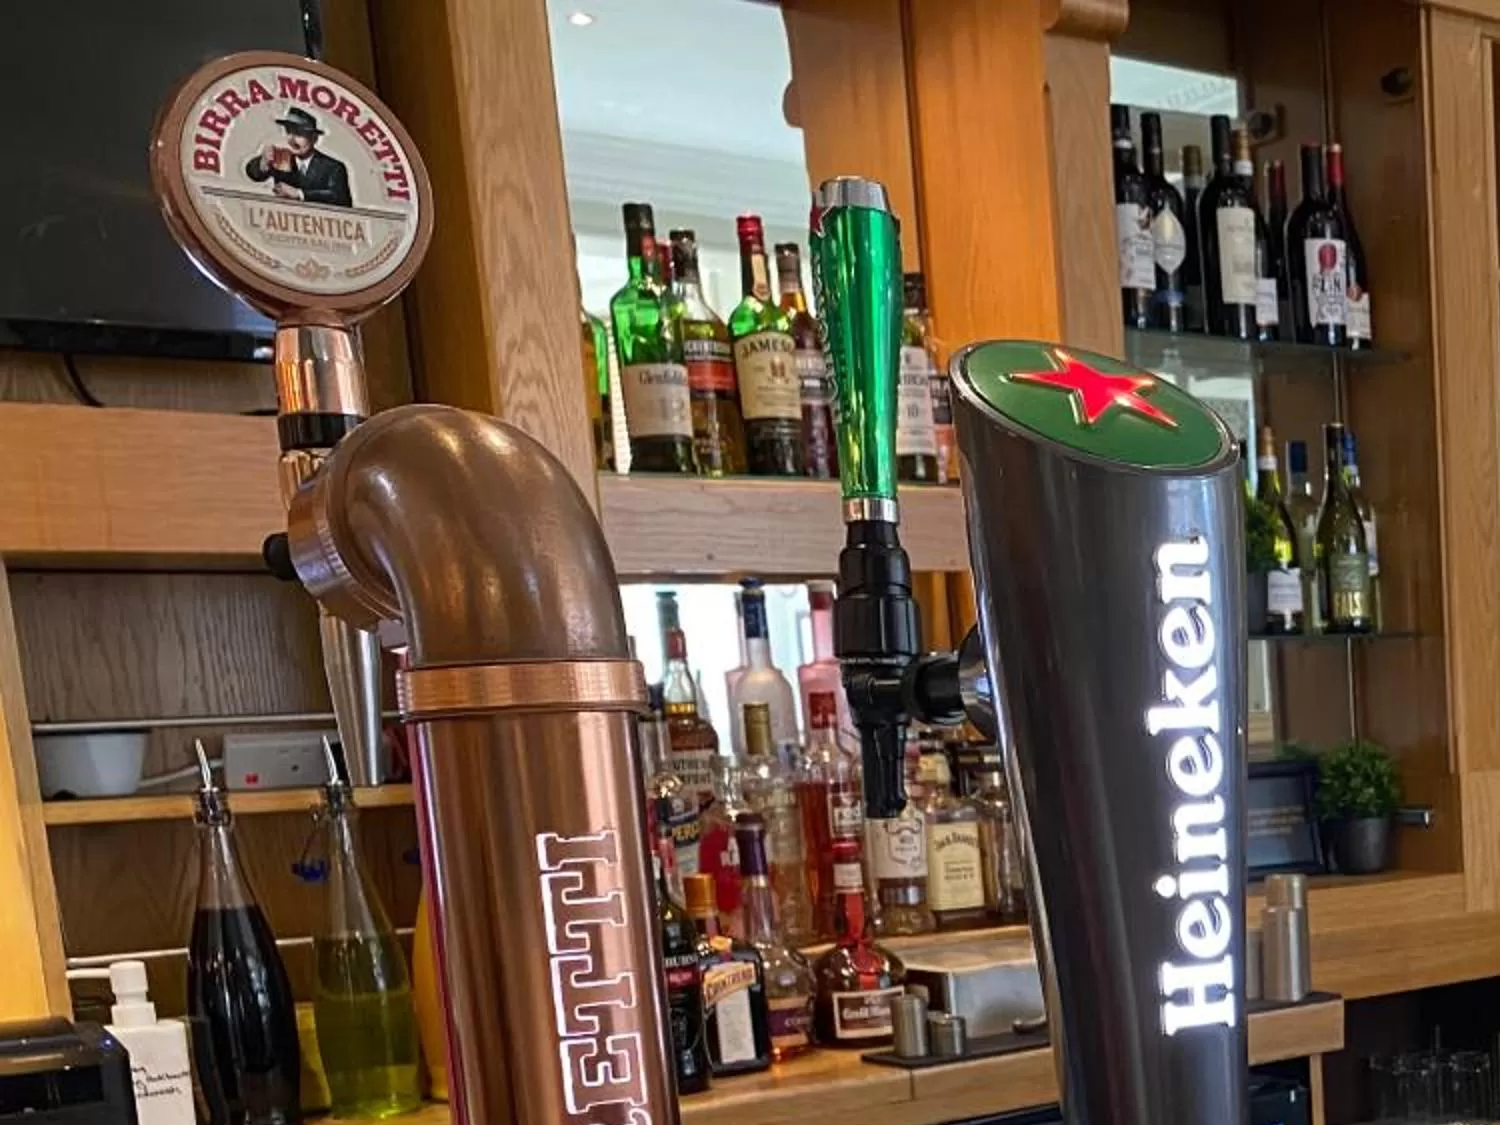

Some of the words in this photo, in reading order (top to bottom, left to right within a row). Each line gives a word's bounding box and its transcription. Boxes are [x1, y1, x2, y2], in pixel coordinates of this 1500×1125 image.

[194, 79, 274, 173] BIRRA
[277, 75, 410, 200] MORETTI
[249, 207, 366, 241] L'AUTENTICA
[1144, 535, 1237, 1037] Heineken
